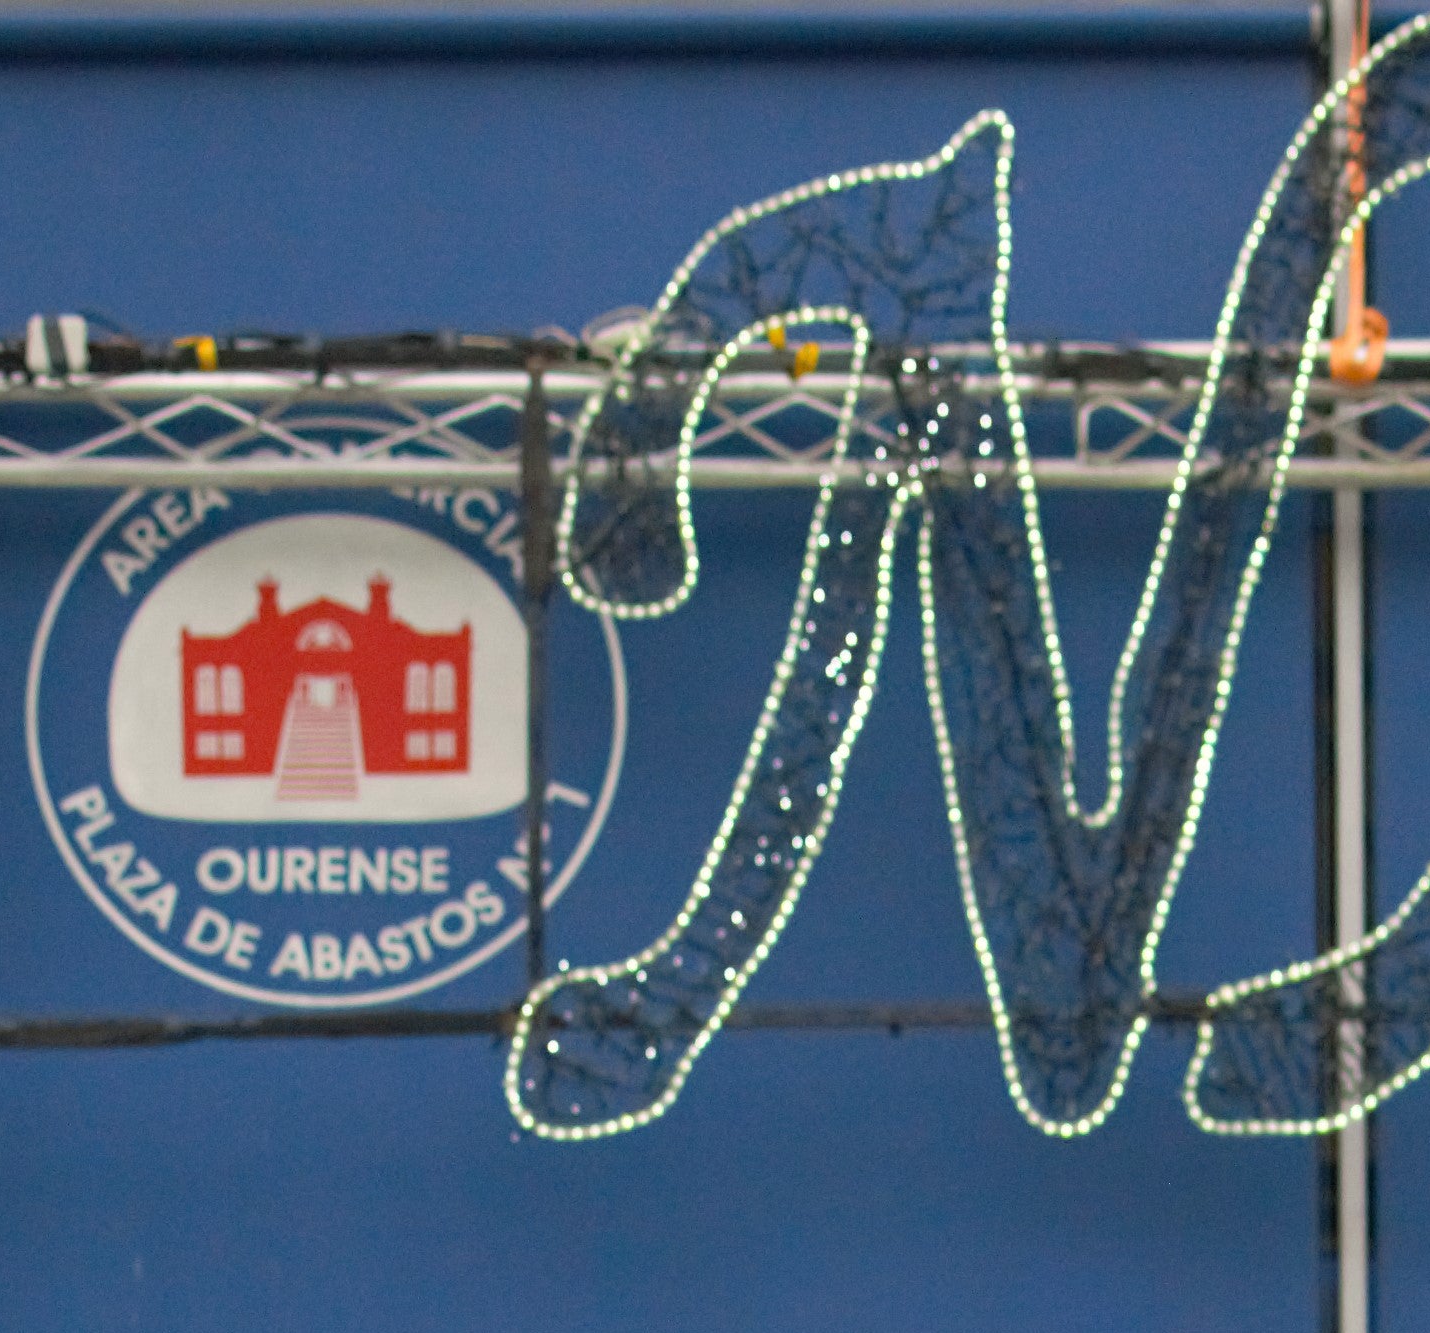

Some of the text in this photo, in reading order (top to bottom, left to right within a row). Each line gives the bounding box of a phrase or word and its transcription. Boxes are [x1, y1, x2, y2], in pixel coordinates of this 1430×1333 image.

[60, 785, 179, 932] PLAZA
[184, 907, 262, 968] DE
[269, 880, 506, 981] ABASTOS
[196, 847, 450, 894] OURENSE
